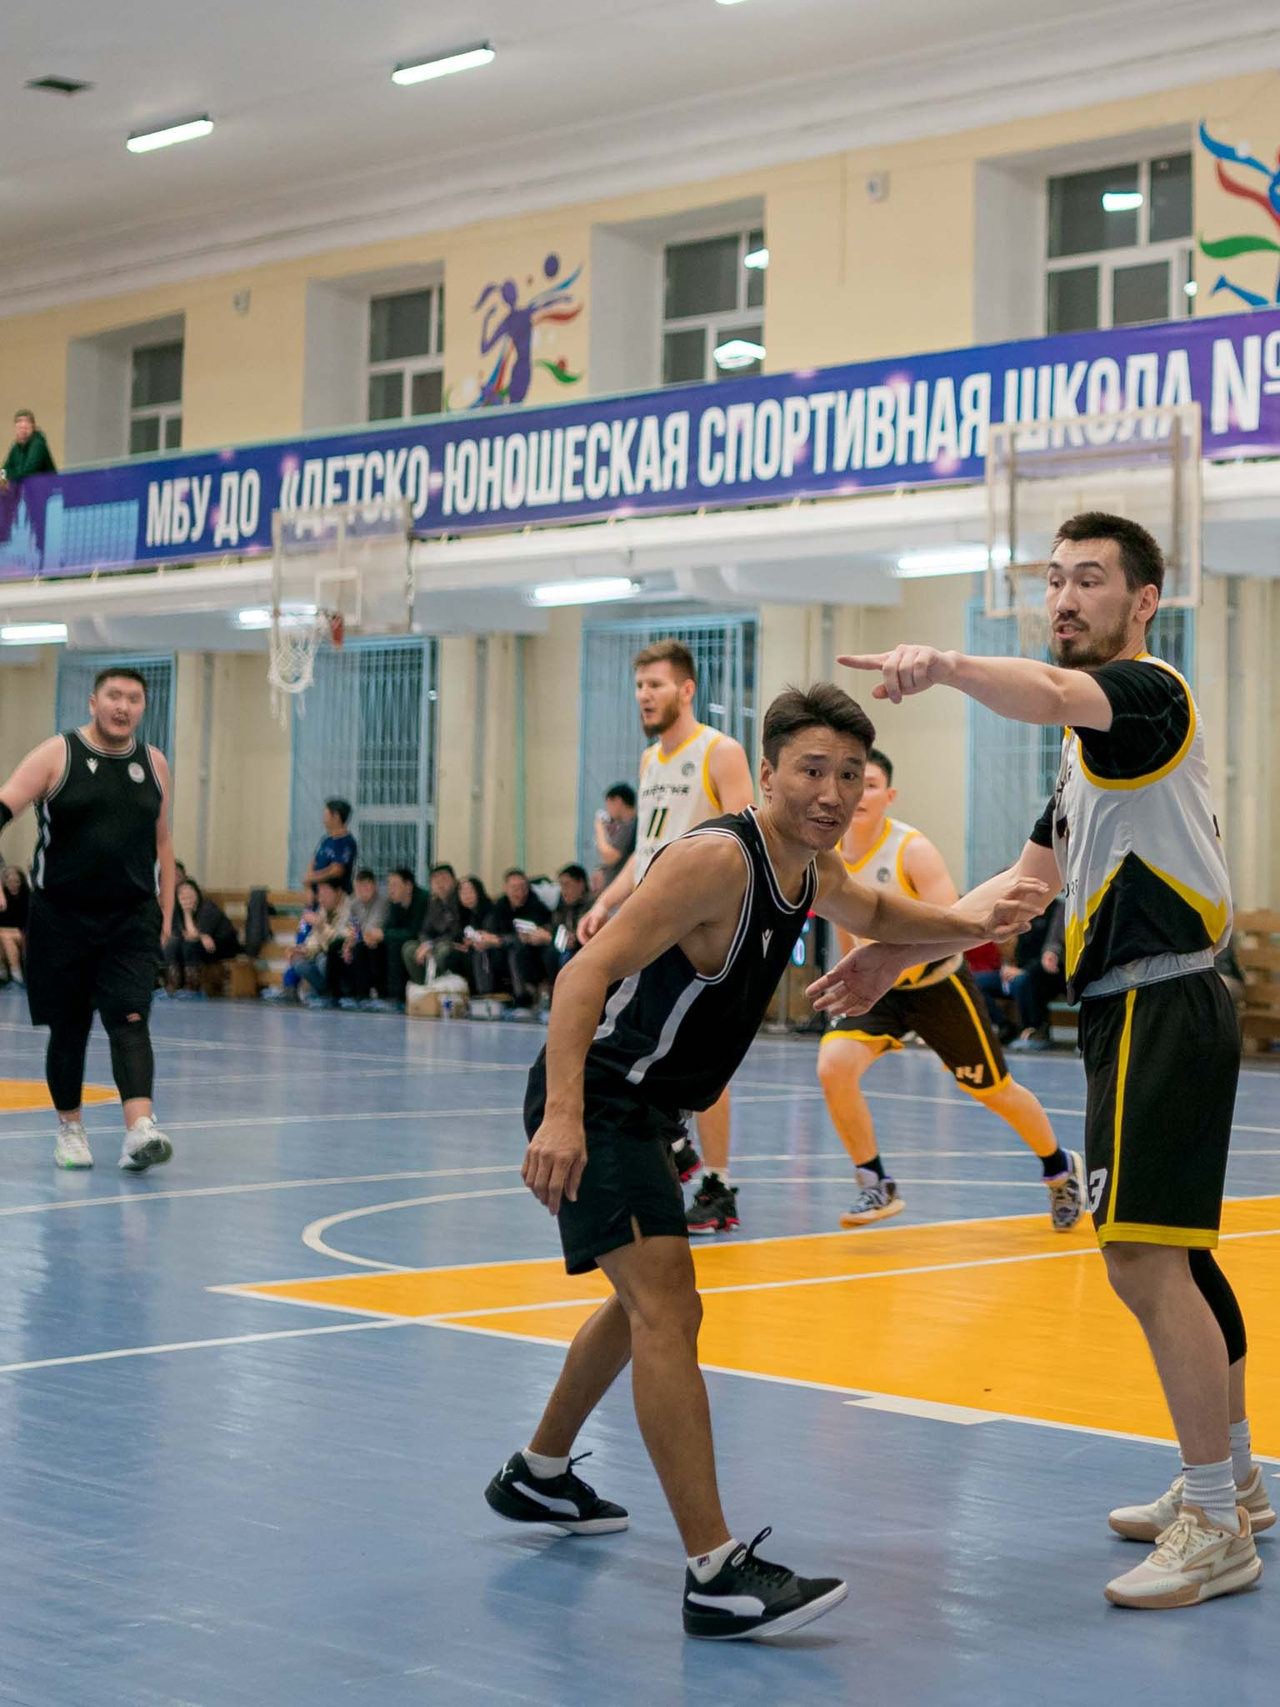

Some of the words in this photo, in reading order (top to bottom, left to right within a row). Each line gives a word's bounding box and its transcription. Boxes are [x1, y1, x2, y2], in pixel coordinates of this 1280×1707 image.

[146, 474, 211, 547] МБУ
[213, 468, 262, 548] ДО
[698, 373, 992, 488] СПОРТИВНАЯ
[1003, 349, 1194, 453] ШКОЛА
[646, 806, 669, 838] 11
